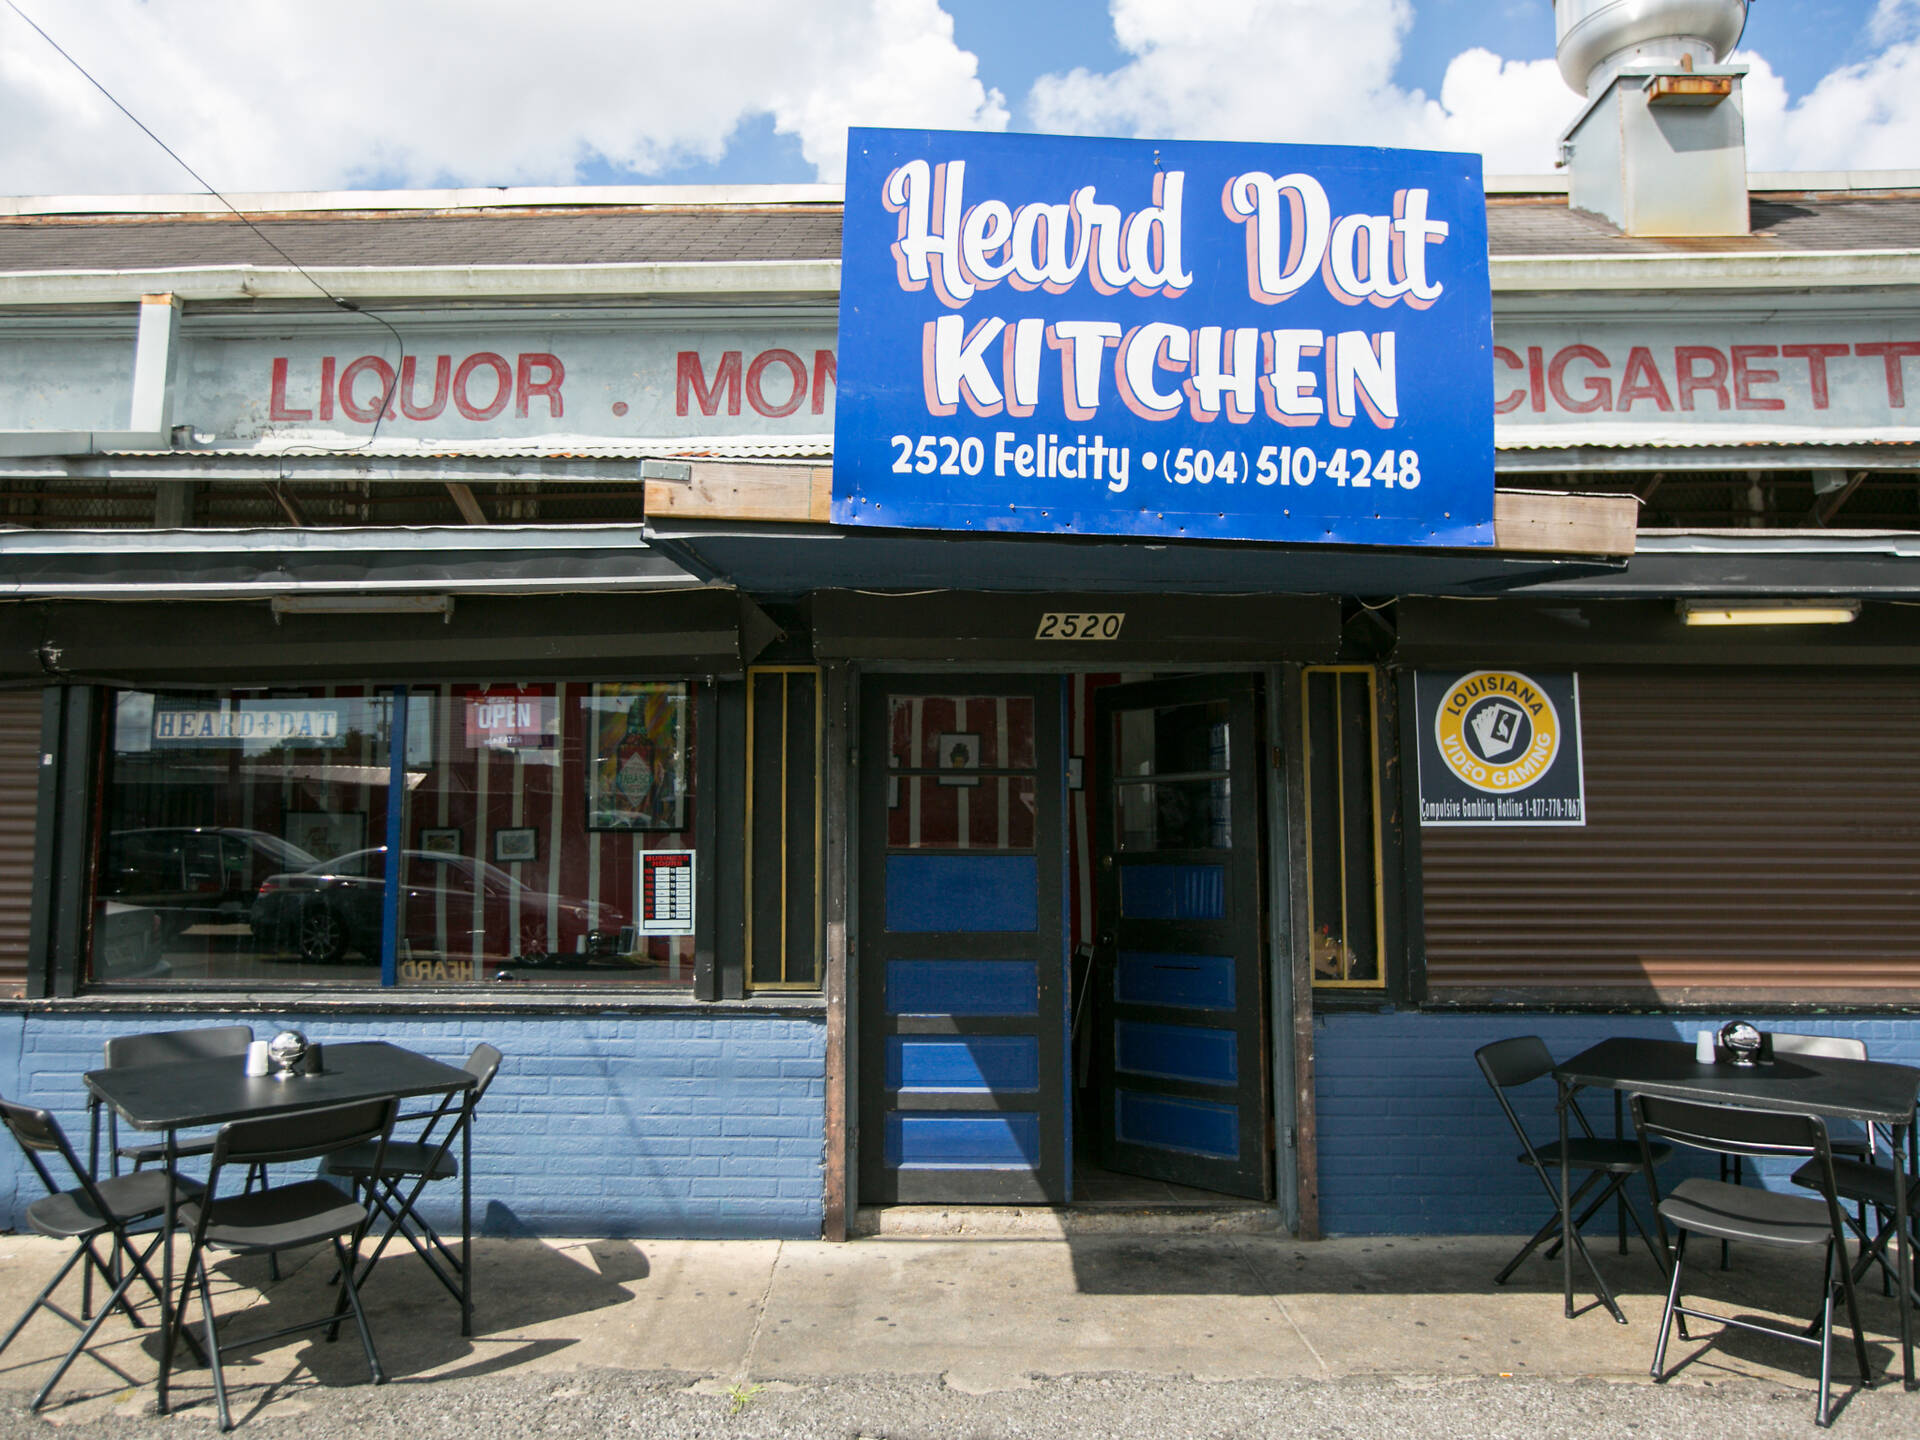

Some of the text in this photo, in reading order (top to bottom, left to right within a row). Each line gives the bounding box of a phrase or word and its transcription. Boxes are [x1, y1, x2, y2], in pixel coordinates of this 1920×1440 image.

[881, 158, 1449, 311] Heard Dat
[269, 351, 566, 423] LIQUOR
[923, 314, 1399, 430] KITCHEN
[891, 432, 1422, 493] 2520 Felicity (504) 510-4248
[1039, 614, 1120, 638] 2520
[477, 703, 531, 729] OPEN
[1446, 676, 1544, 717] LOUISIANA
[158, 711, 336, 738] HEARD DAT
[1443, 732, 1552, 786] VIDEO GAMING
[1421, 797, 1460, 820] Compulsive
[1462, 797, 1496, 821] Gambling
[1497, 797, 1524, 818] Hotline
